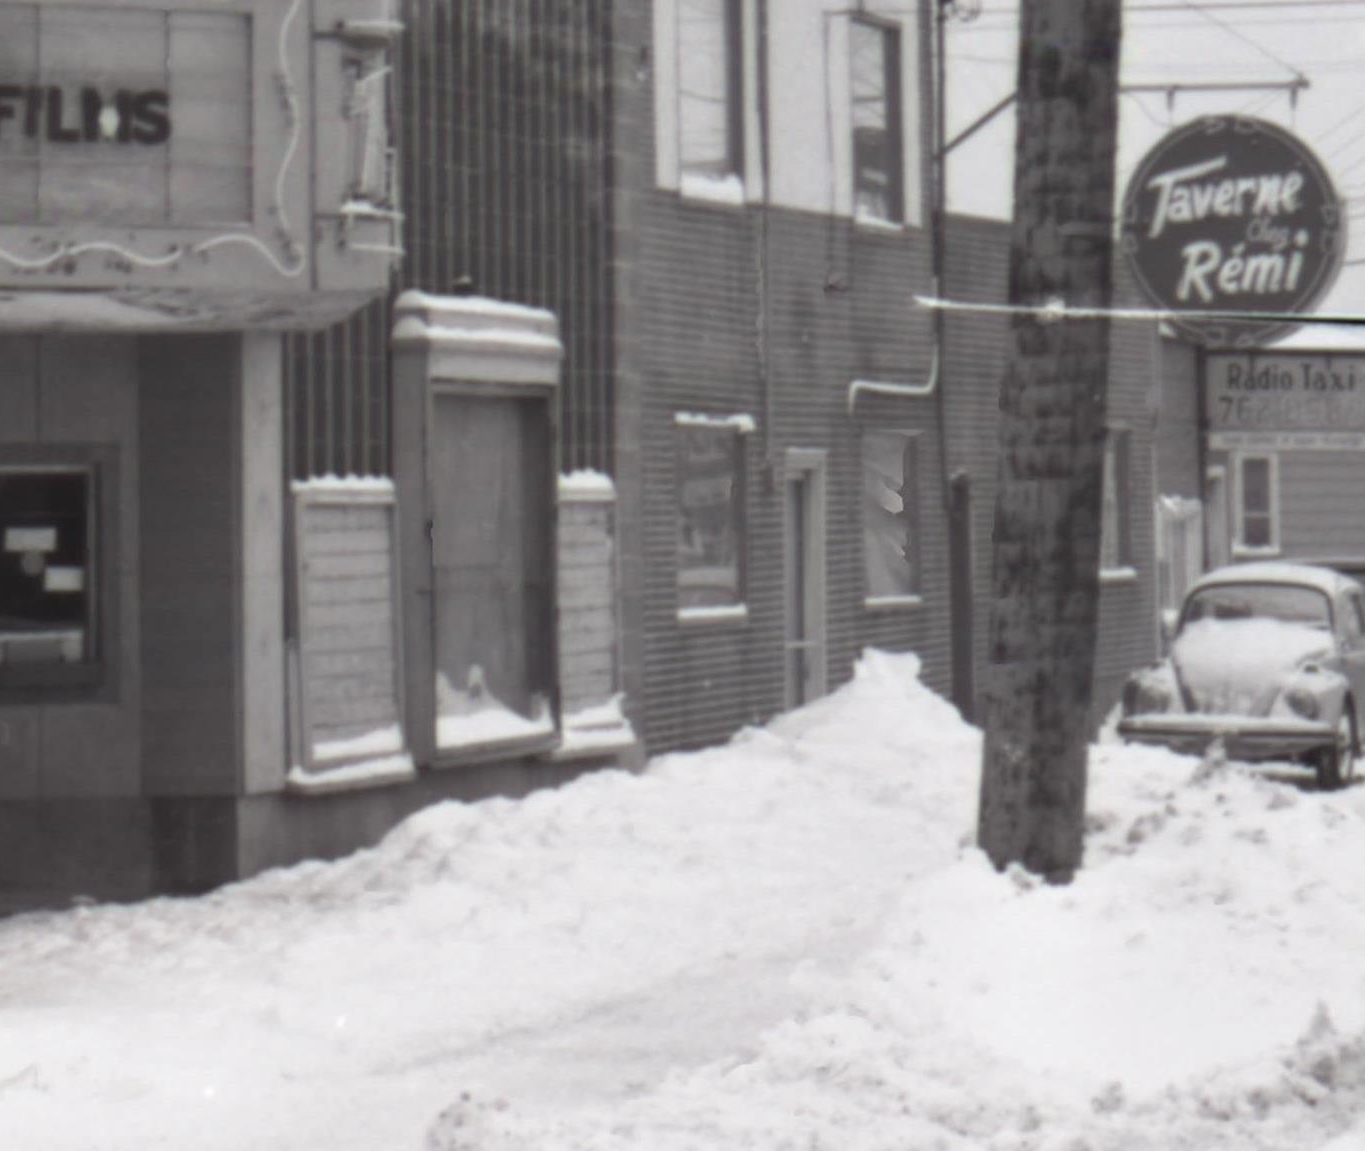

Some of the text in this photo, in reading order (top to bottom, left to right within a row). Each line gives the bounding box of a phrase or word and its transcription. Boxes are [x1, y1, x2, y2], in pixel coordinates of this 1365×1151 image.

[1148, 155, 1303, 239] Taverne
[1177, 230, 1309, 302] Rémi
[1227, 363, 1356, 391] Radio Taxi
